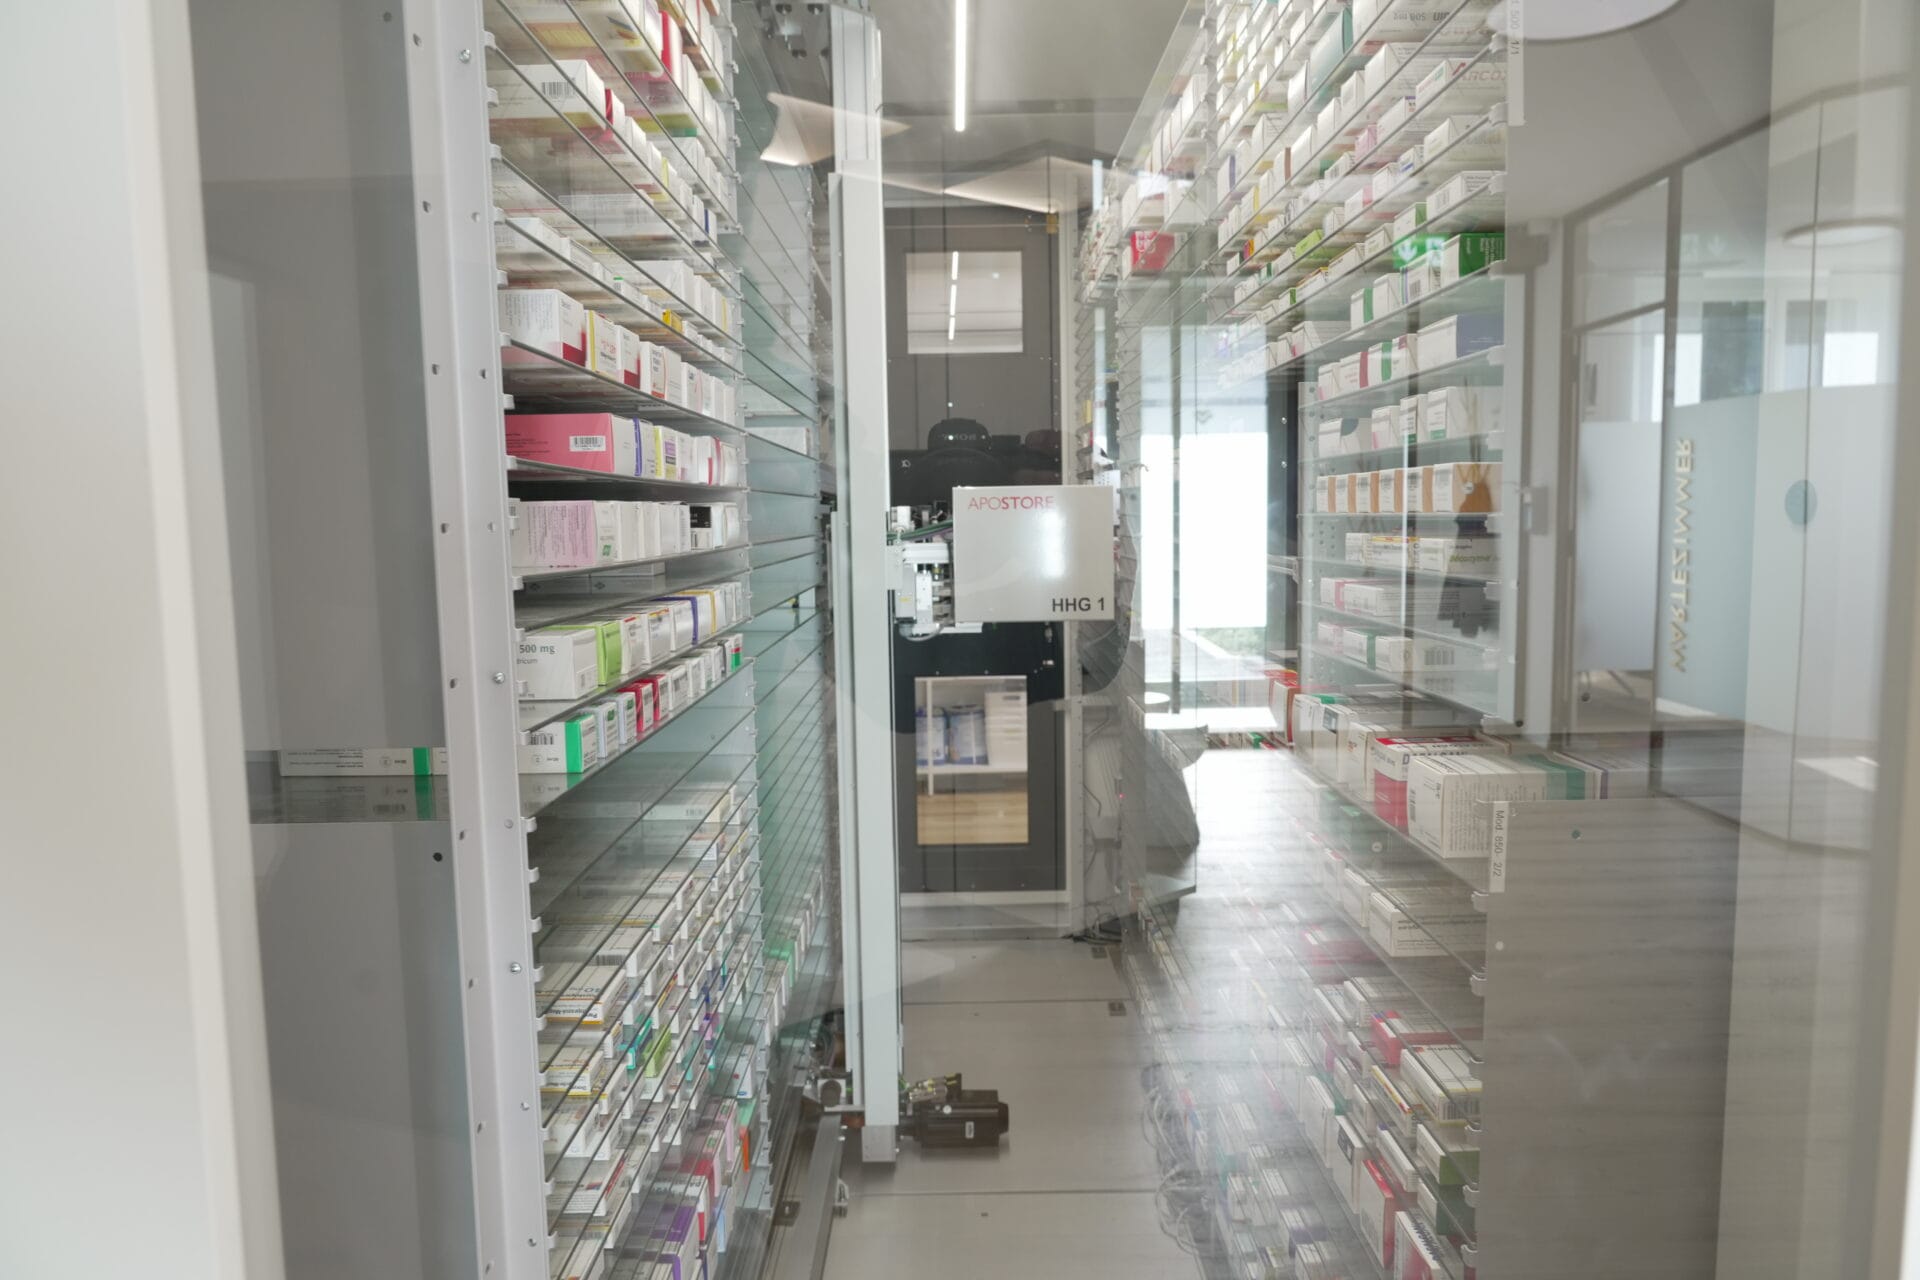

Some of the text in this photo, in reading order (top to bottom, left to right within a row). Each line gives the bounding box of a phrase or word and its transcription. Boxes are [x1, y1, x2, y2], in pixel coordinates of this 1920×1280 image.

[968, 495, 1054, 510] APOSTORE
[1052, 597, 1105, 613] HHG 1
[519, 644, 556, 655] 500 mg
